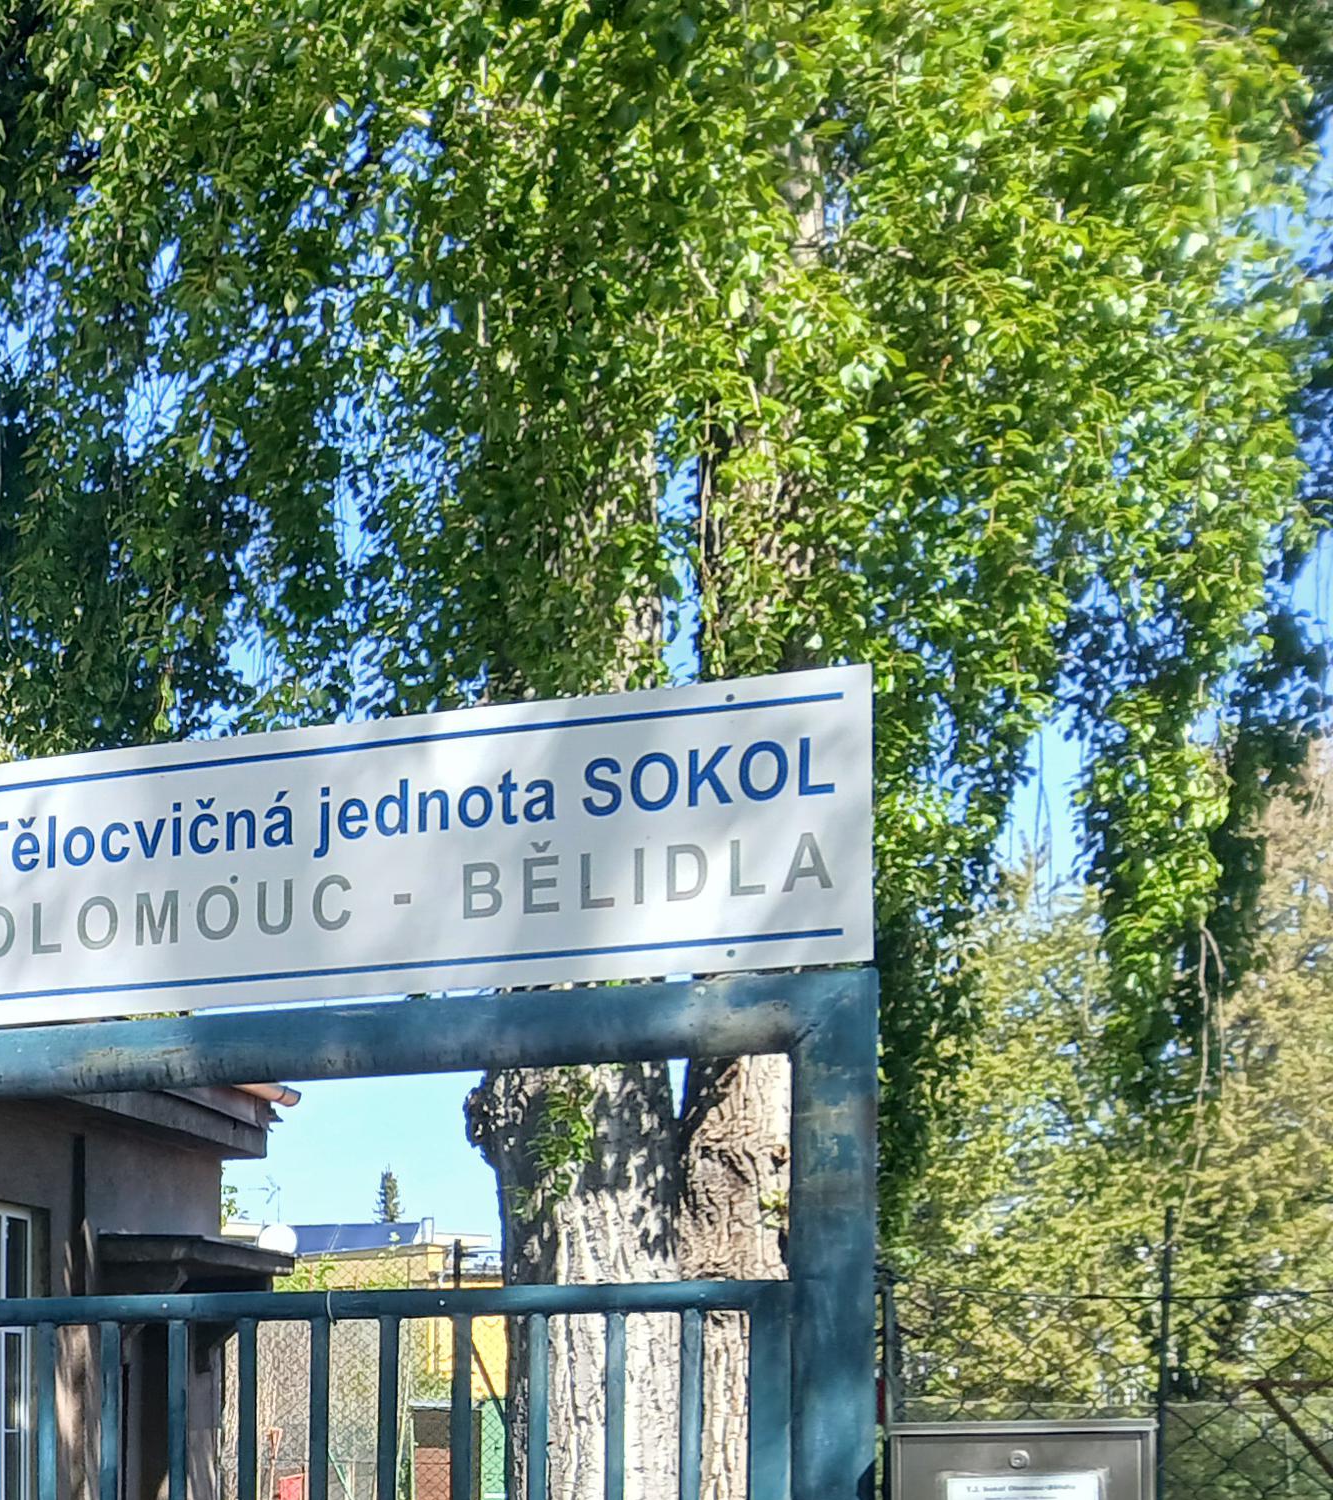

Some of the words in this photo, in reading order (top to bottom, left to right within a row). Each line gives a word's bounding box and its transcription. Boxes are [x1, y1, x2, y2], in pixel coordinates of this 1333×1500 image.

[312, 769, 556, 859] jednota
[581, 736, 836, 817] SOKOL
[461, 831, 834, 920] BĚLIDLA
